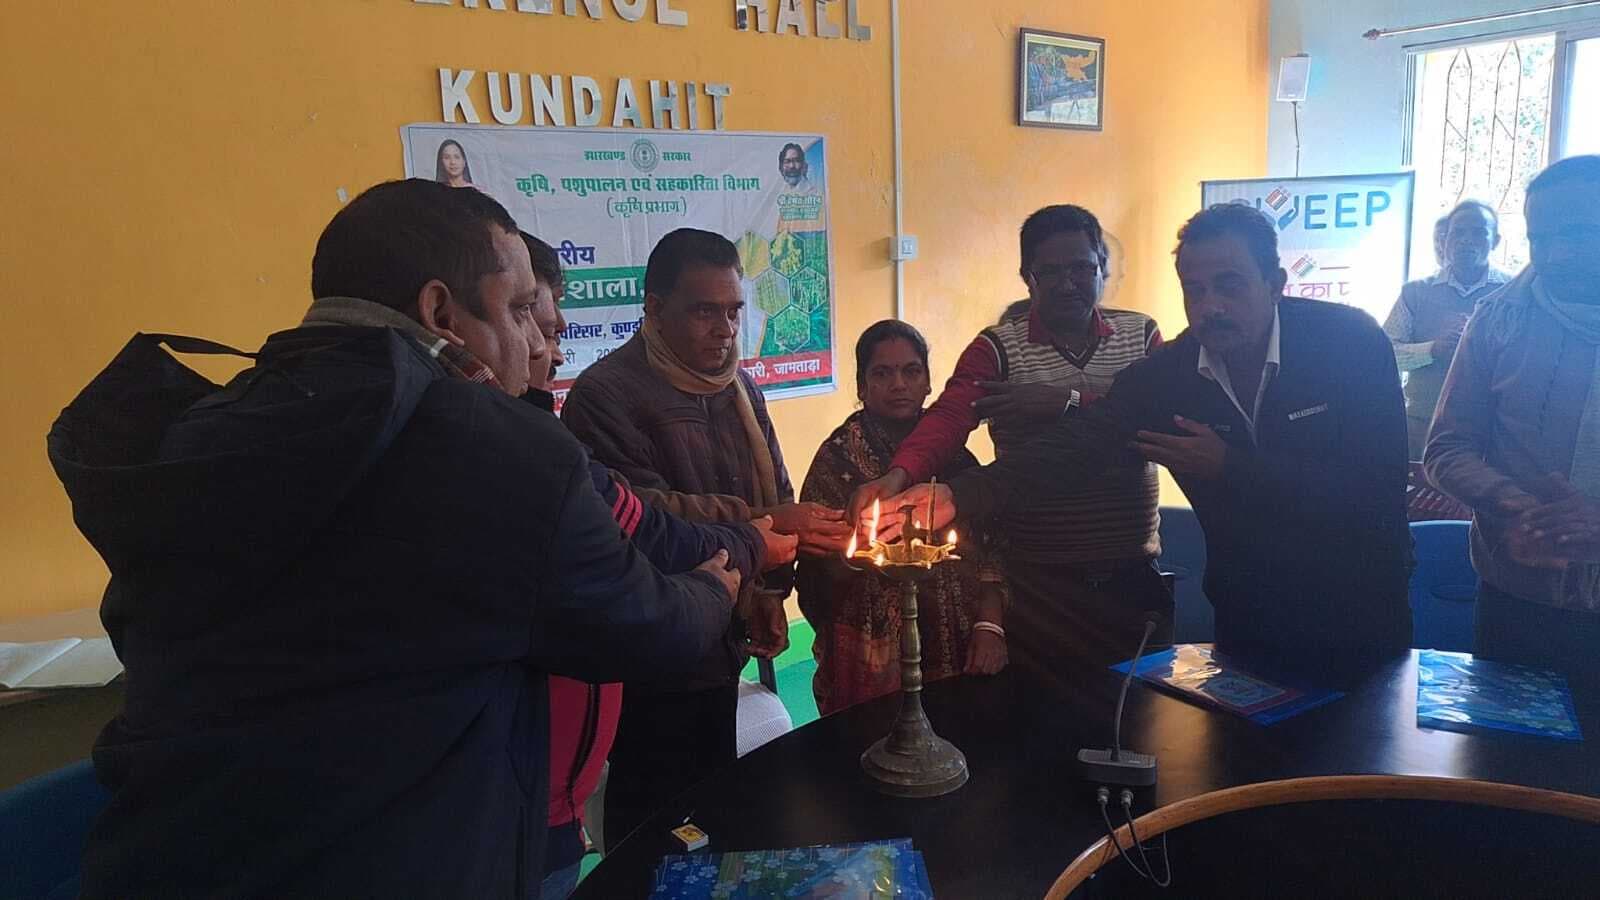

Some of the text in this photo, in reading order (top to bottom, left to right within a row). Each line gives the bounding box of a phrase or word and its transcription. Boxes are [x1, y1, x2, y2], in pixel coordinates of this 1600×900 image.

[439, 68, 732, 131] KUNDAHIT
[662, 151, 692, 162] सरकार
[560, 177, 627, 197] पशुपालन
[631, 173, 652, 192] एवं
[655, 174, 720, 192] सहकारिता
[722, 174, 761, 192] विभाग
